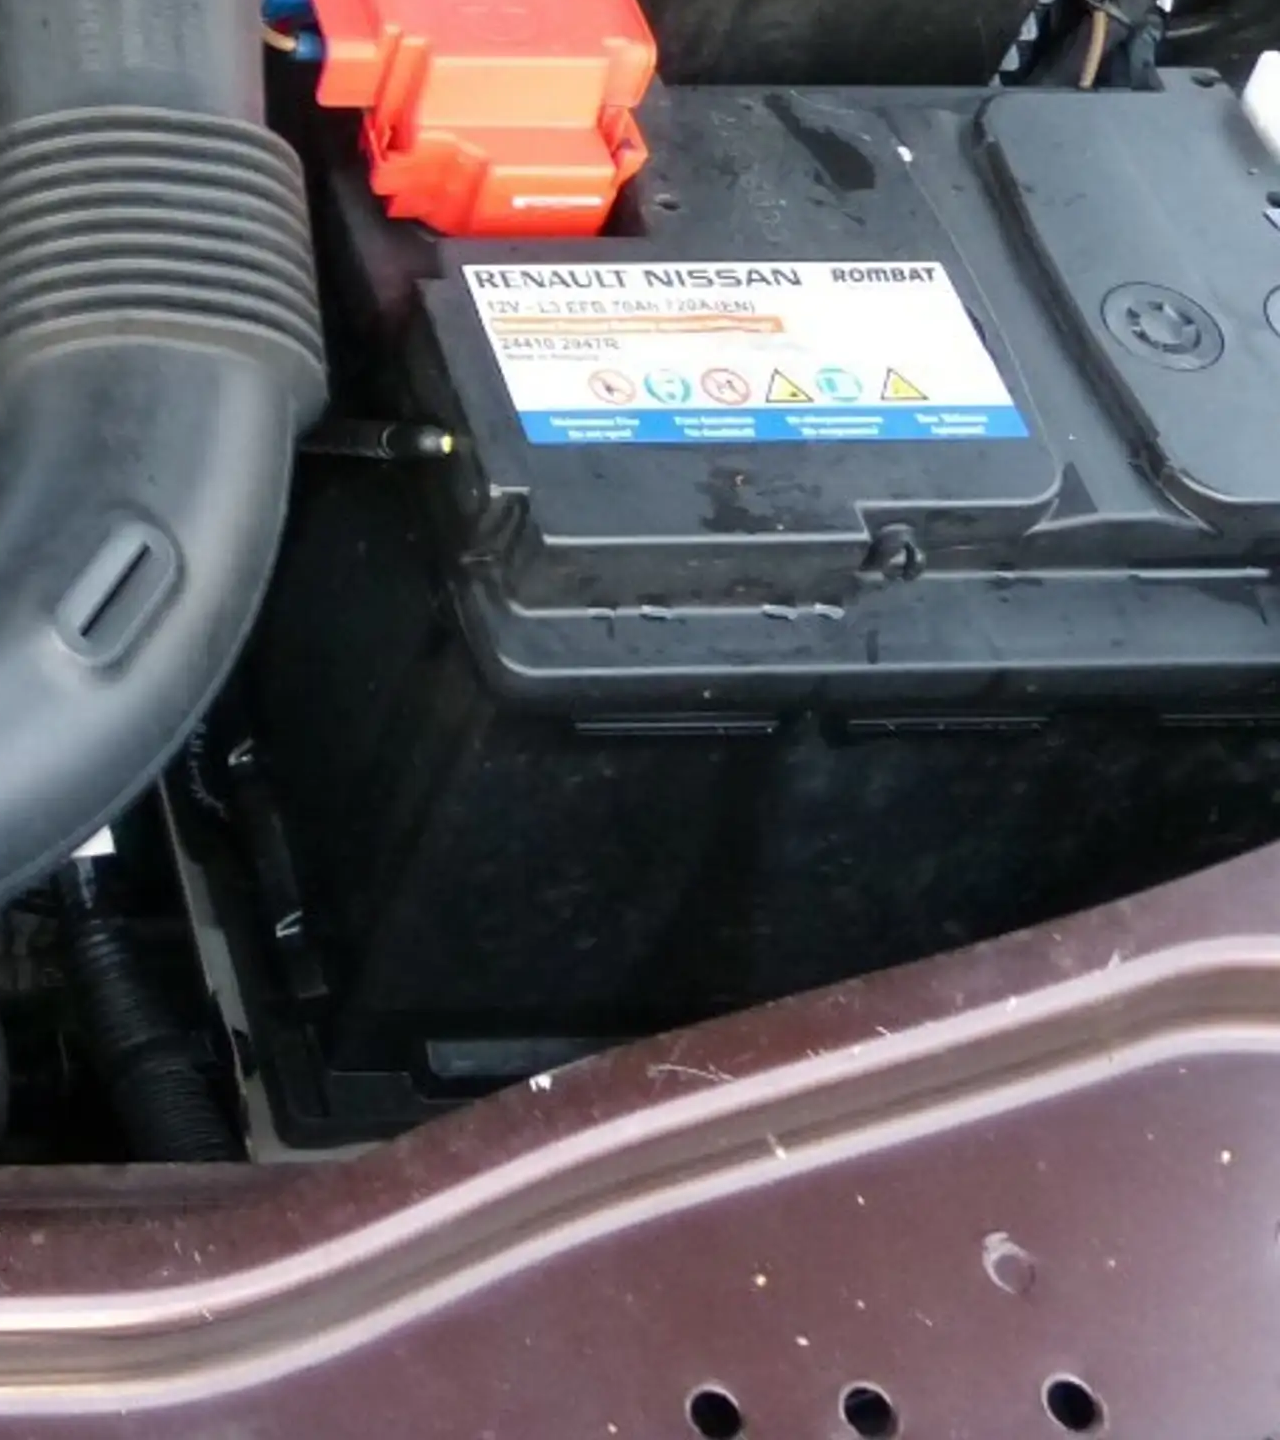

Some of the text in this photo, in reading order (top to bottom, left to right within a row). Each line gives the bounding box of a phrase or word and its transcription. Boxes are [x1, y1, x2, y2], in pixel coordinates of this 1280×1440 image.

[473, 267, 936, 289] RENAULT NISSAN ROMBAT
